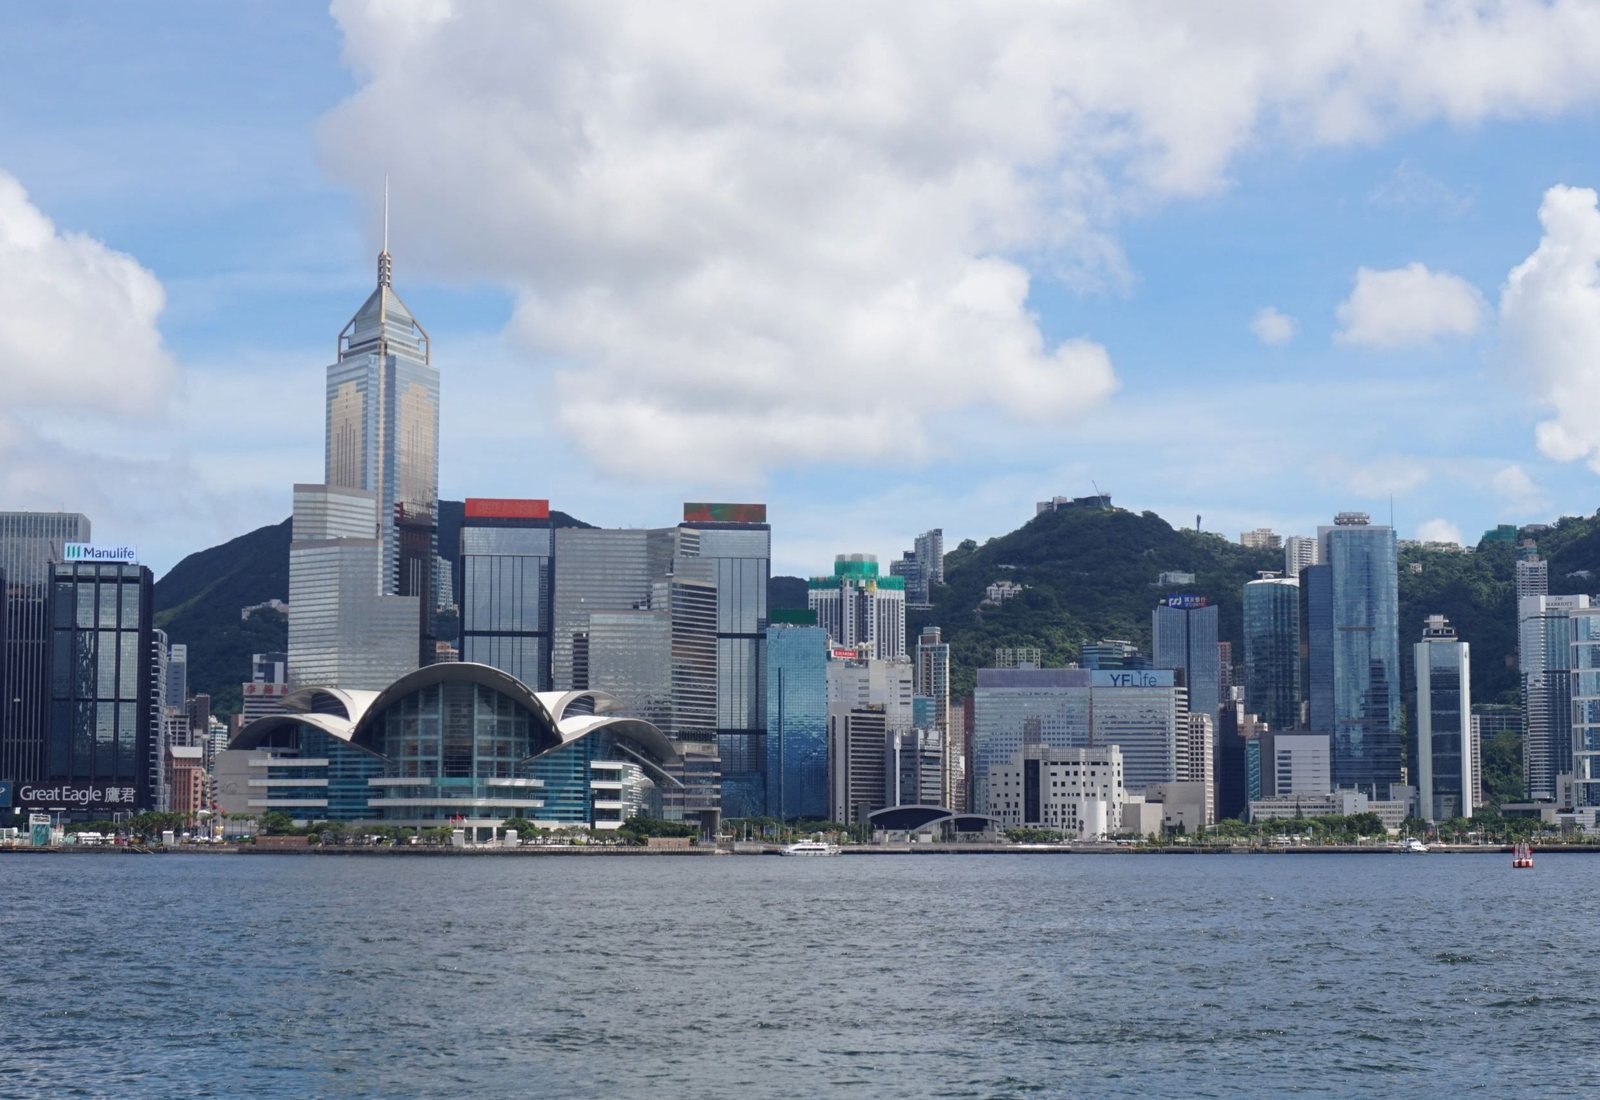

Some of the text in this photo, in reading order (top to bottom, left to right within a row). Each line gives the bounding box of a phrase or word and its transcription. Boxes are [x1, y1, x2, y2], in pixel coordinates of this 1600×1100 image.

[84, 547, 134, 559] Manulife
[20, 785, 136, 805] Great Eagle 鷹君
